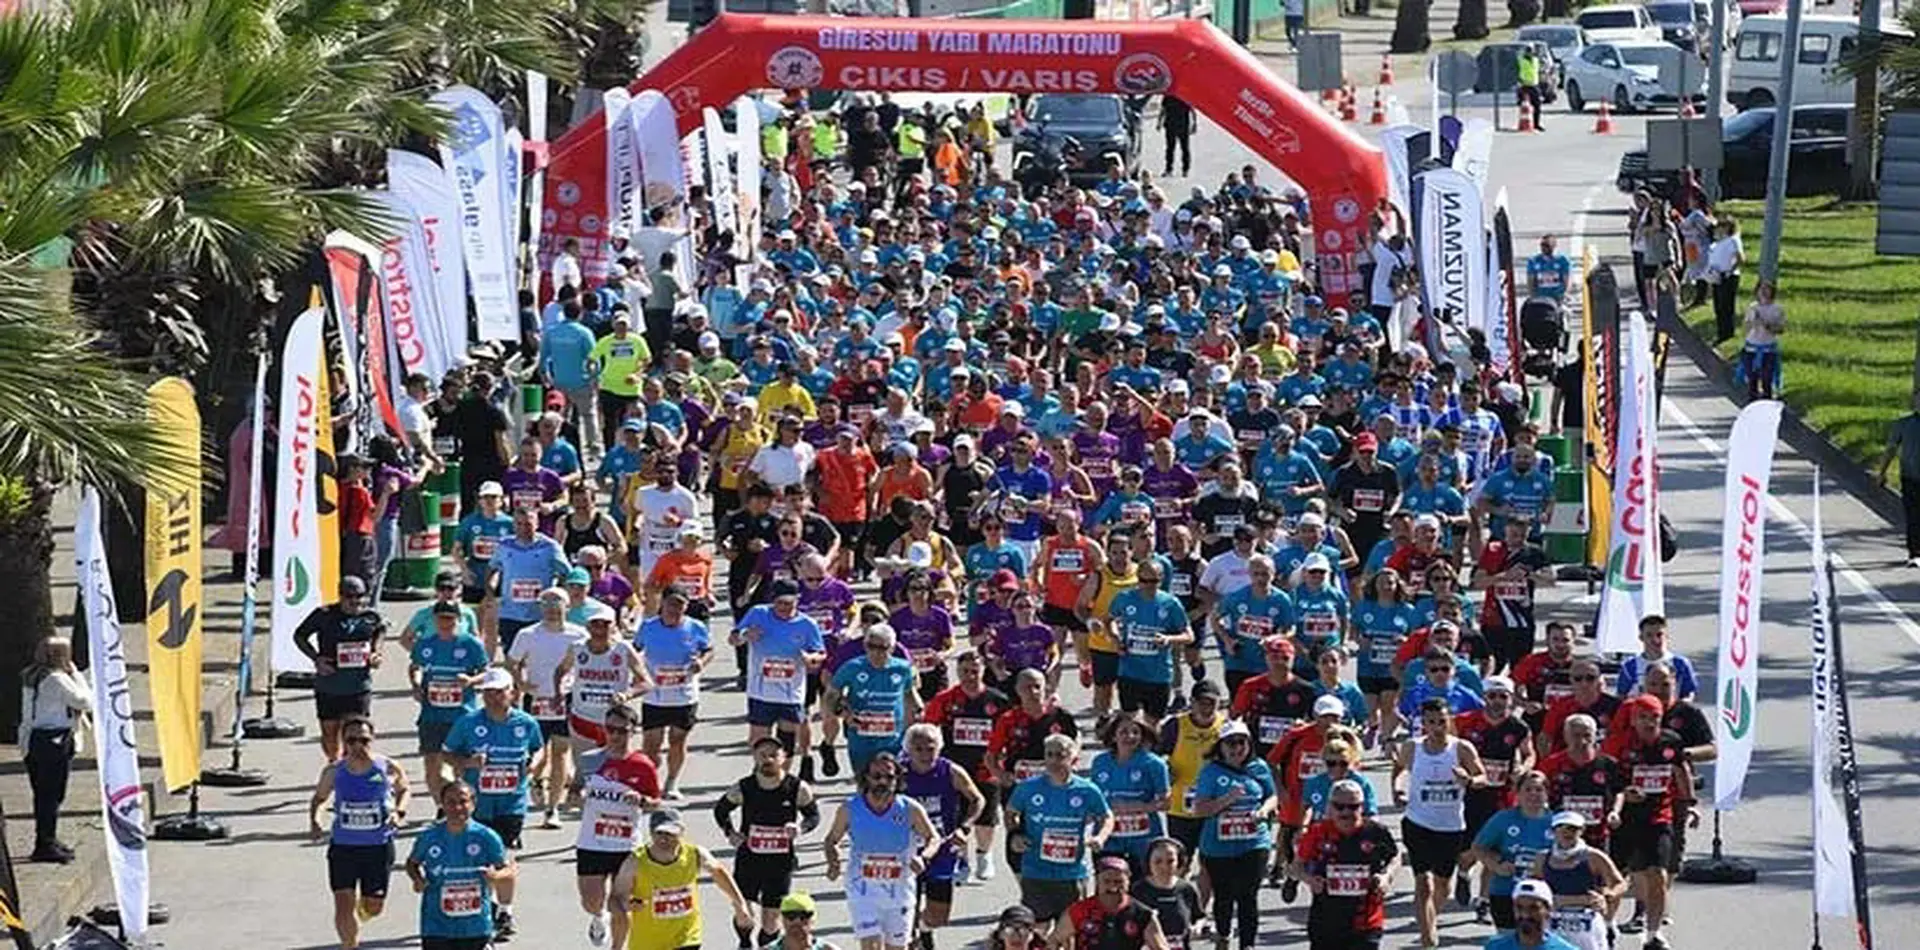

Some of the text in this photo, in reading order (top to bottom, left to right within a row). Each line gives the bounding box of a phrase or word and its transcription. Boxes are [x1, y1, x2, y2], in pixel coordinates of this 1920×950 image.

[818, 26, 1122, 55] GİRESUN YARI MARATONU
[1731, 474, 1761, 669] Castrol
